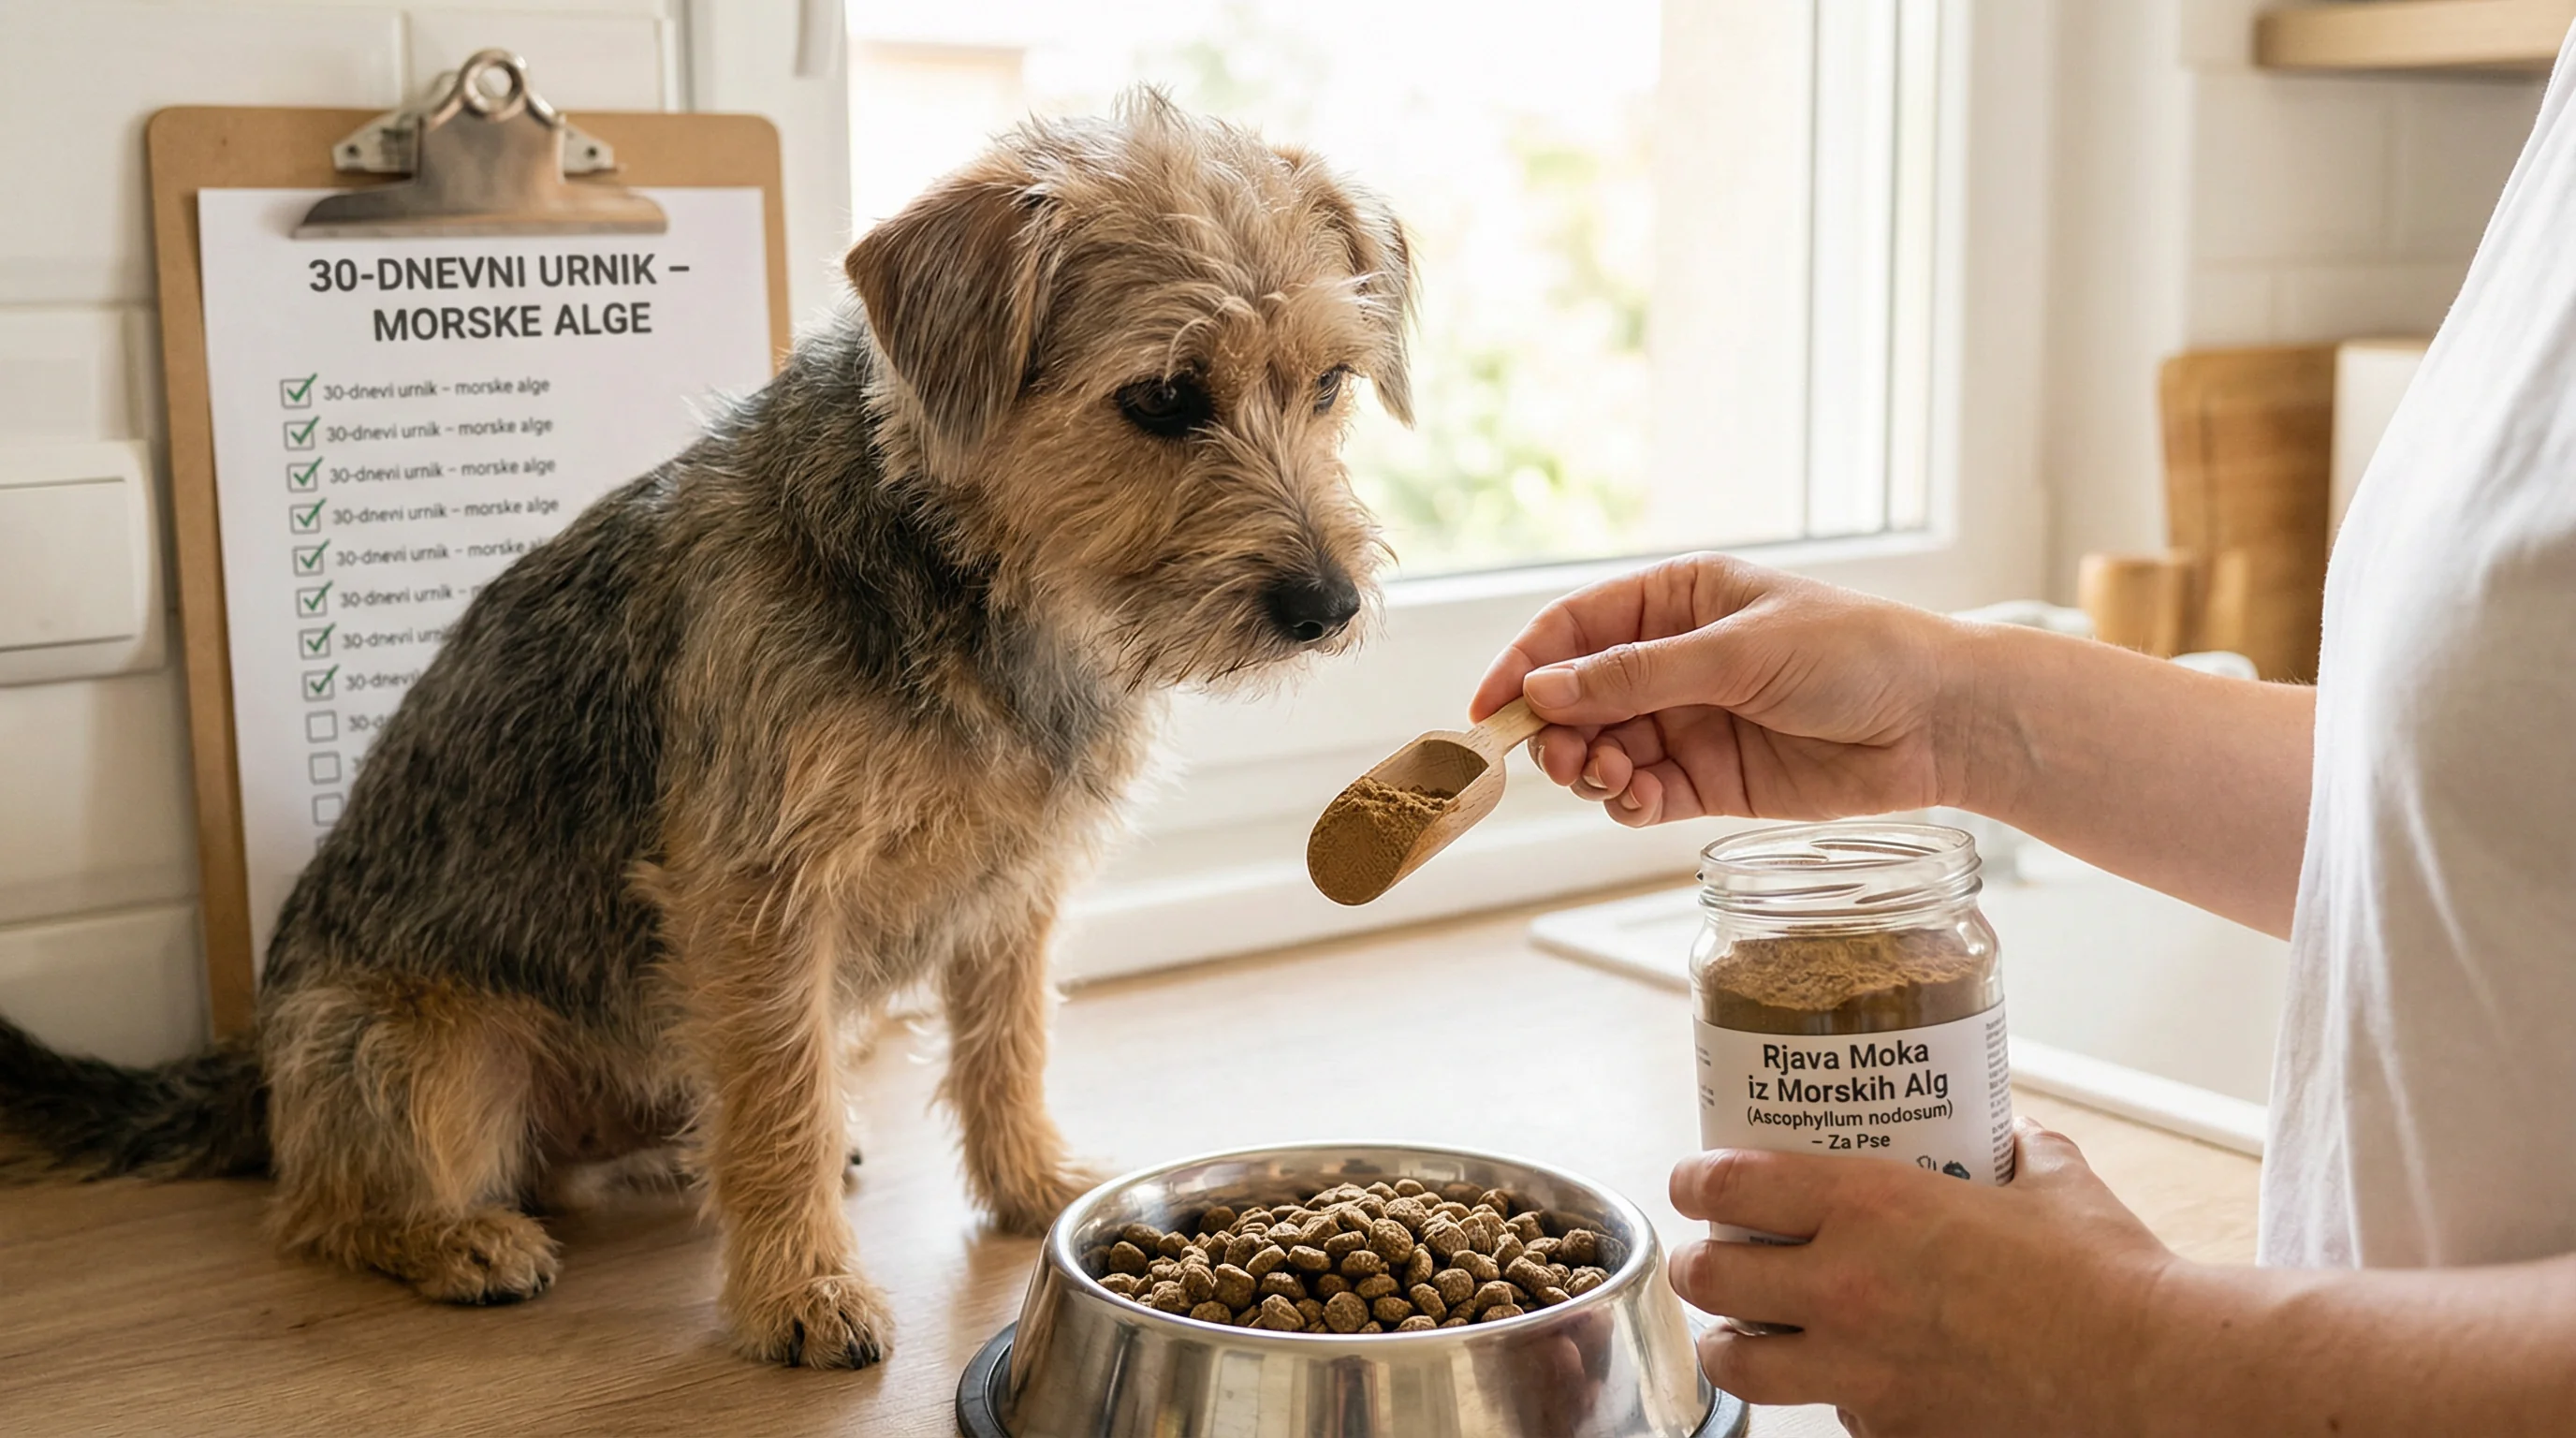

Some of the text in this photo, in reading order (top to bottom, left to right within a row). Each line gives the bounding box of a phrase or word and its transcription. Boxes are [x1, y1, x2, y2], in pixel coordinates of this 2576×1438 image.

[309, 256, 525, 292] 30-DNEVNI
[539, 254, 657, 287] URNIK
[373, 302, 651, 342] MORSKE ALGE
[399, 381, 437, 398] urnik
[456, 377, 514, 394] morske
[517, 377, 550, 396] alge
[402, 421, 441, 439] urnik
[459, 418, 517, 435] morske
[520, 418, 553, 436] alge
[404, 462, 443, 480] urnik
[461, 459, 520, 476] morske
[523, 458, 555, 476] alge
[408, 504, 447, 521] urnik
[464, 499, 522, 516] morske
[526, 498, 559, 515] alge
[411, 546, 449, 563] urnik
[468, 540, 525, 556] morske
[415, 587, 451, 602] urnik
[1764, 1040, 1929, 1076] Rjava Moka
[1749, 1075, 1769, 1100] iz
[1778, 1073, 1895, 1103] Morskih
[1905, 1070, 1949, 1099] Alg
[1748, 1099, 1954, 1131] (Ascophyllum nodosum)
[1828, 1135, 1852, 1150] Za
[1857, 1134, 1890, 1149] Pse
